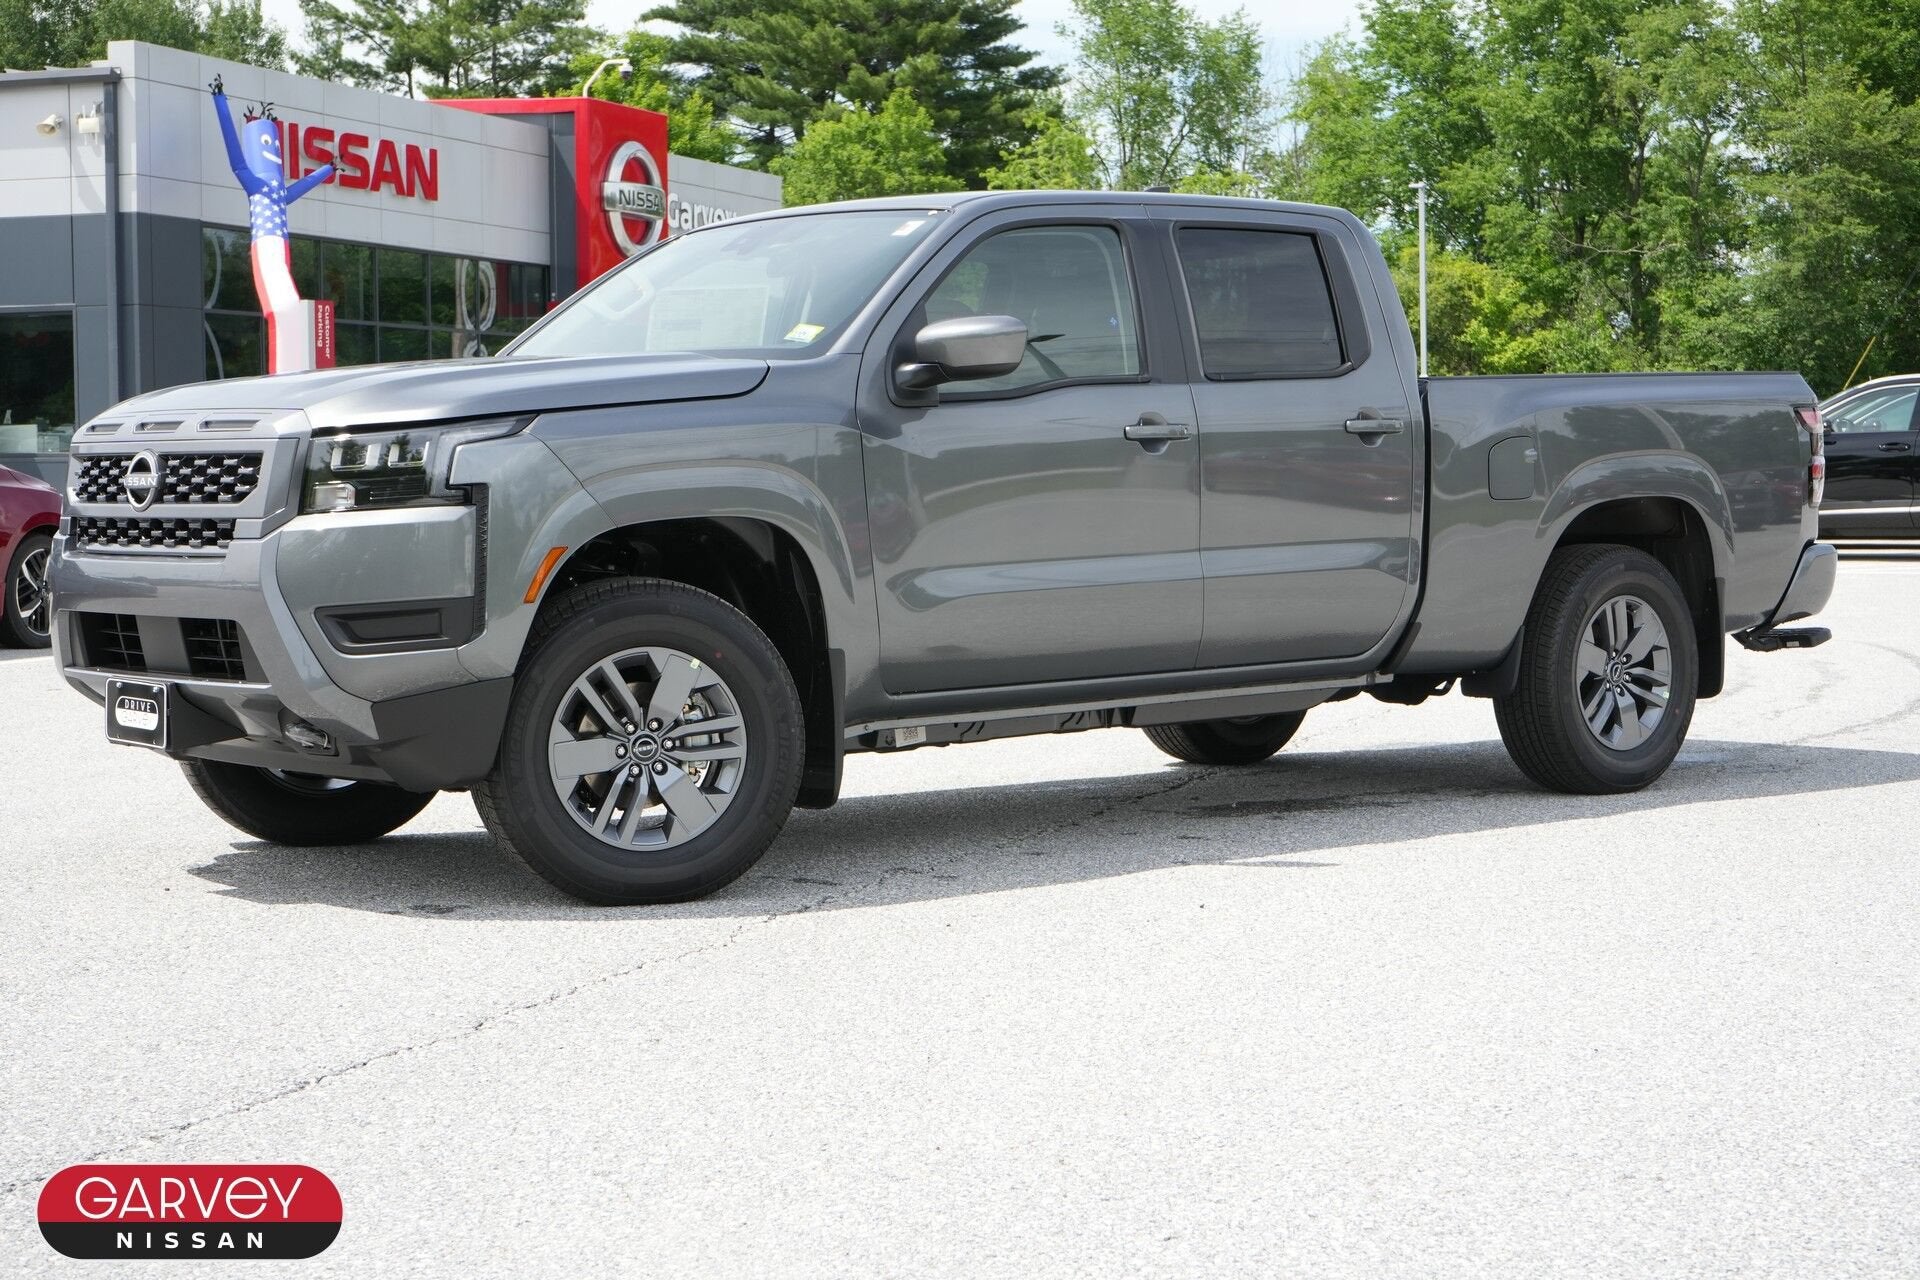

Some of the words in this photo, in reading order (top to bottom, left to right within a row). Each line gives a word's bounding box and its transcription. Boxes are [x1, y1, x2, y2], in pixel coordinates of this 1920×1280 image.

[246, 115, 438, 201] ISSAN
[618, 189, 663, 212] NISSA
[125, 476, 158, 486] SSAN
[124, 699, 151, 713] DRIVE
